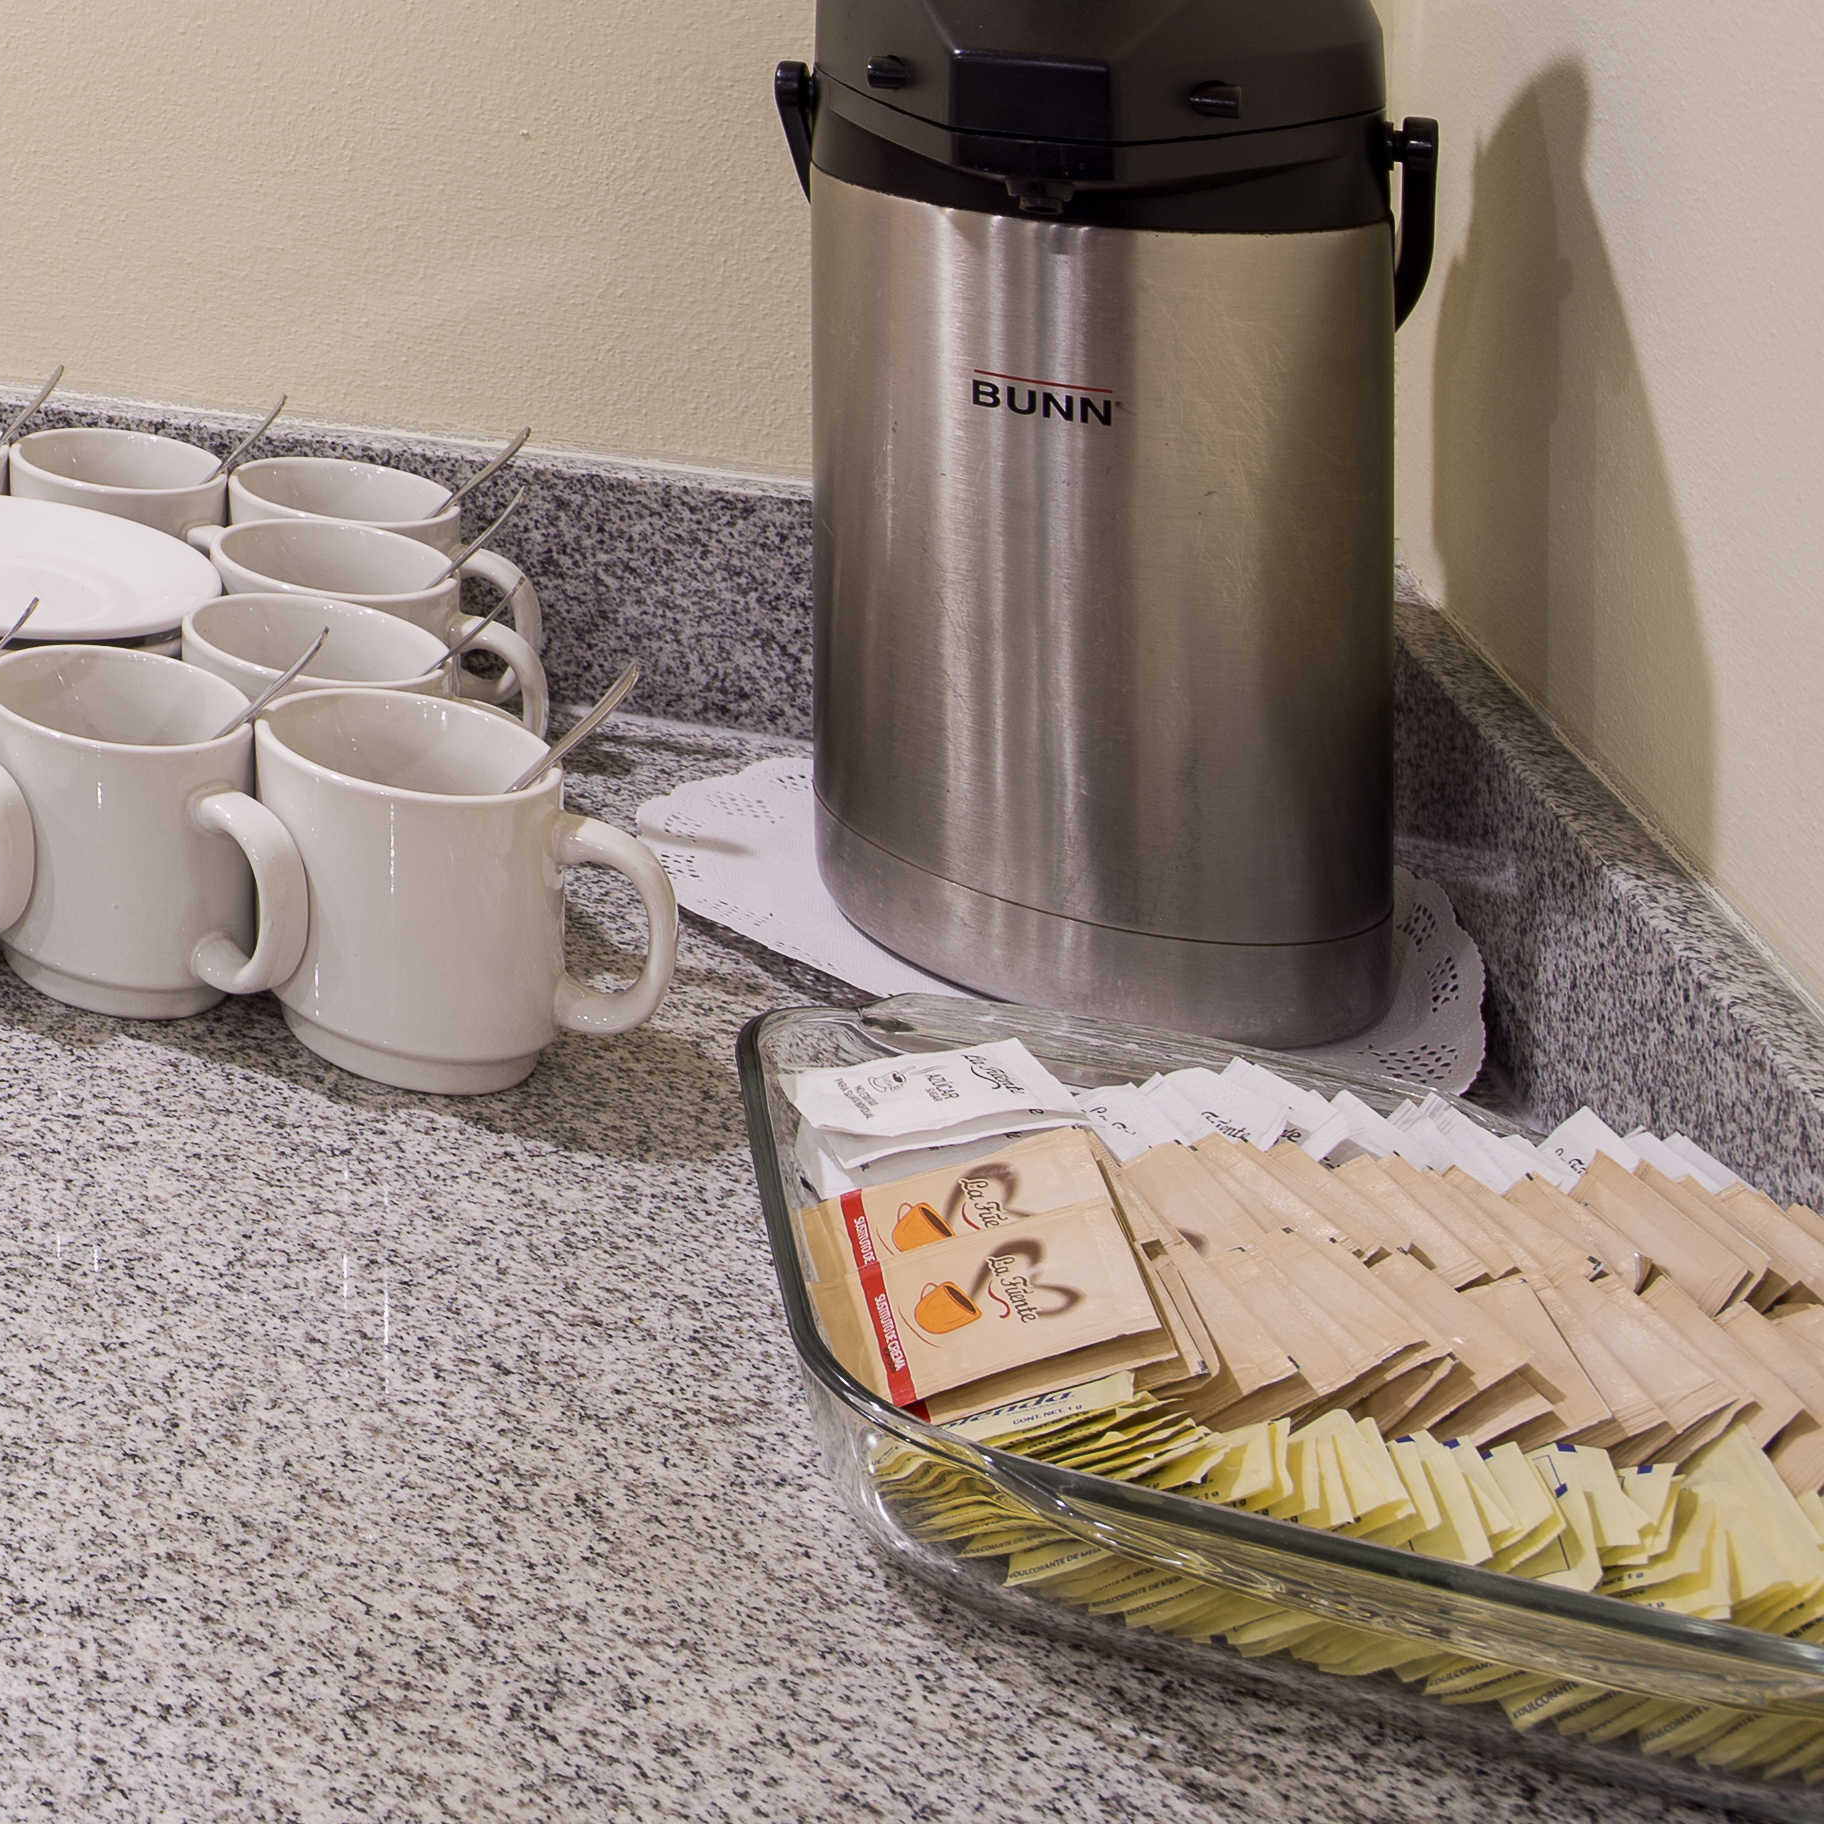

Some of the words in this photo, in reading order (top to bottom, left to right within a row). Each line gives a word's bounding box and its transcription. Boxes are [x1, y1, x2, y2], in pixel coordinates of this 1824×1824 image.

[972, 379, 1112, 426] BUNN
[958, 1178, 989, 1201] La
[852, 1215, 872, 1253] SUSTITUTO
[988, 1256, 1015, 1277] La
[874, 1293, 894, 1333] SUSTITUTO
[884, 1329, 897, 1343] DE
[887, 1339, 906, 1371] CREMA
[1009, 1556, 1065, 1578] EDULCORANTE
[1067, 1553, 1079, 1561] DE
